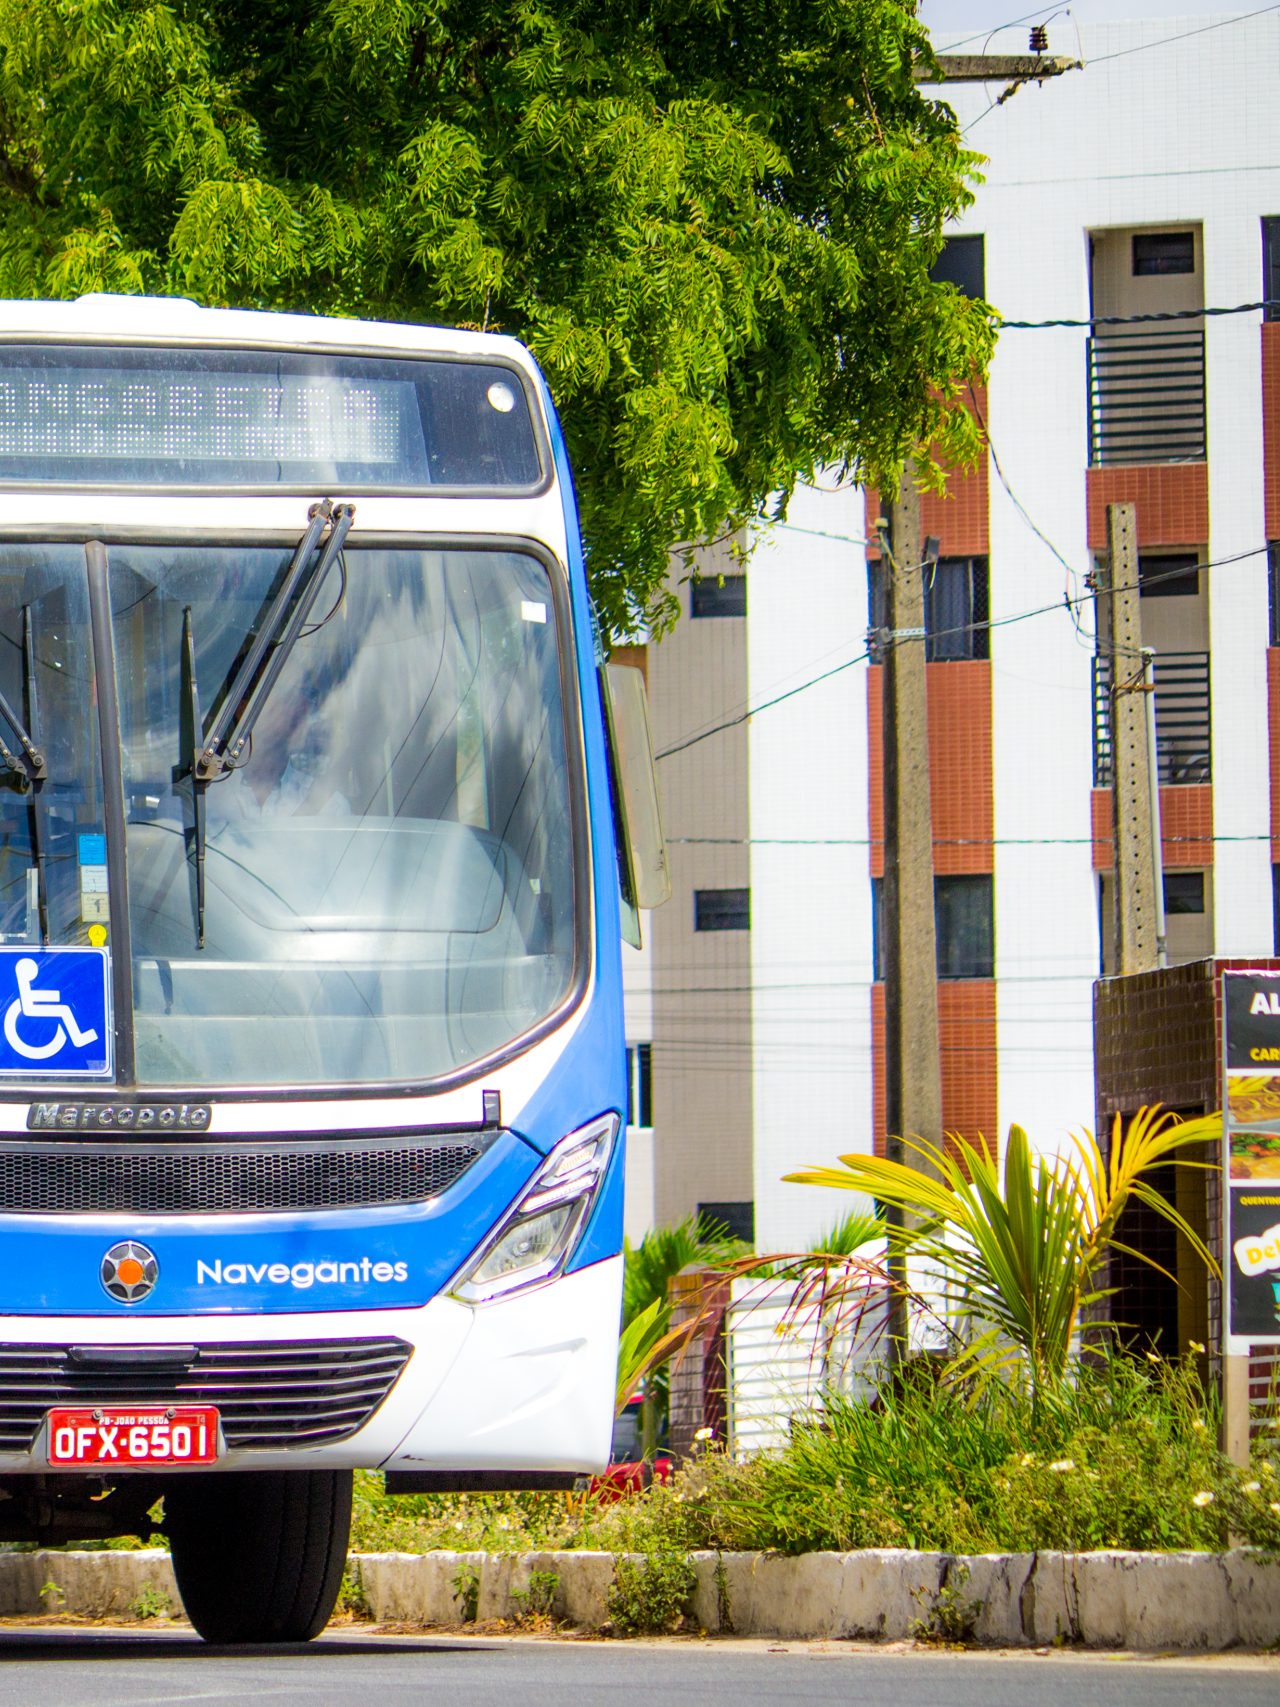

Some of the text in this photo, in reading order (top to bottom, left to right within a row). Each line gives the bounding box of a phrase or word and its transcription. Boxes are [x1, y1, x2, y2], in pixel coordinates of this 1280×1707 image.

[33, 1103, 208, 1129] Marcopolo
[196, 1257, 409, 1290] Navegantes
[138, 1416, 169, 1425] PESSOA
